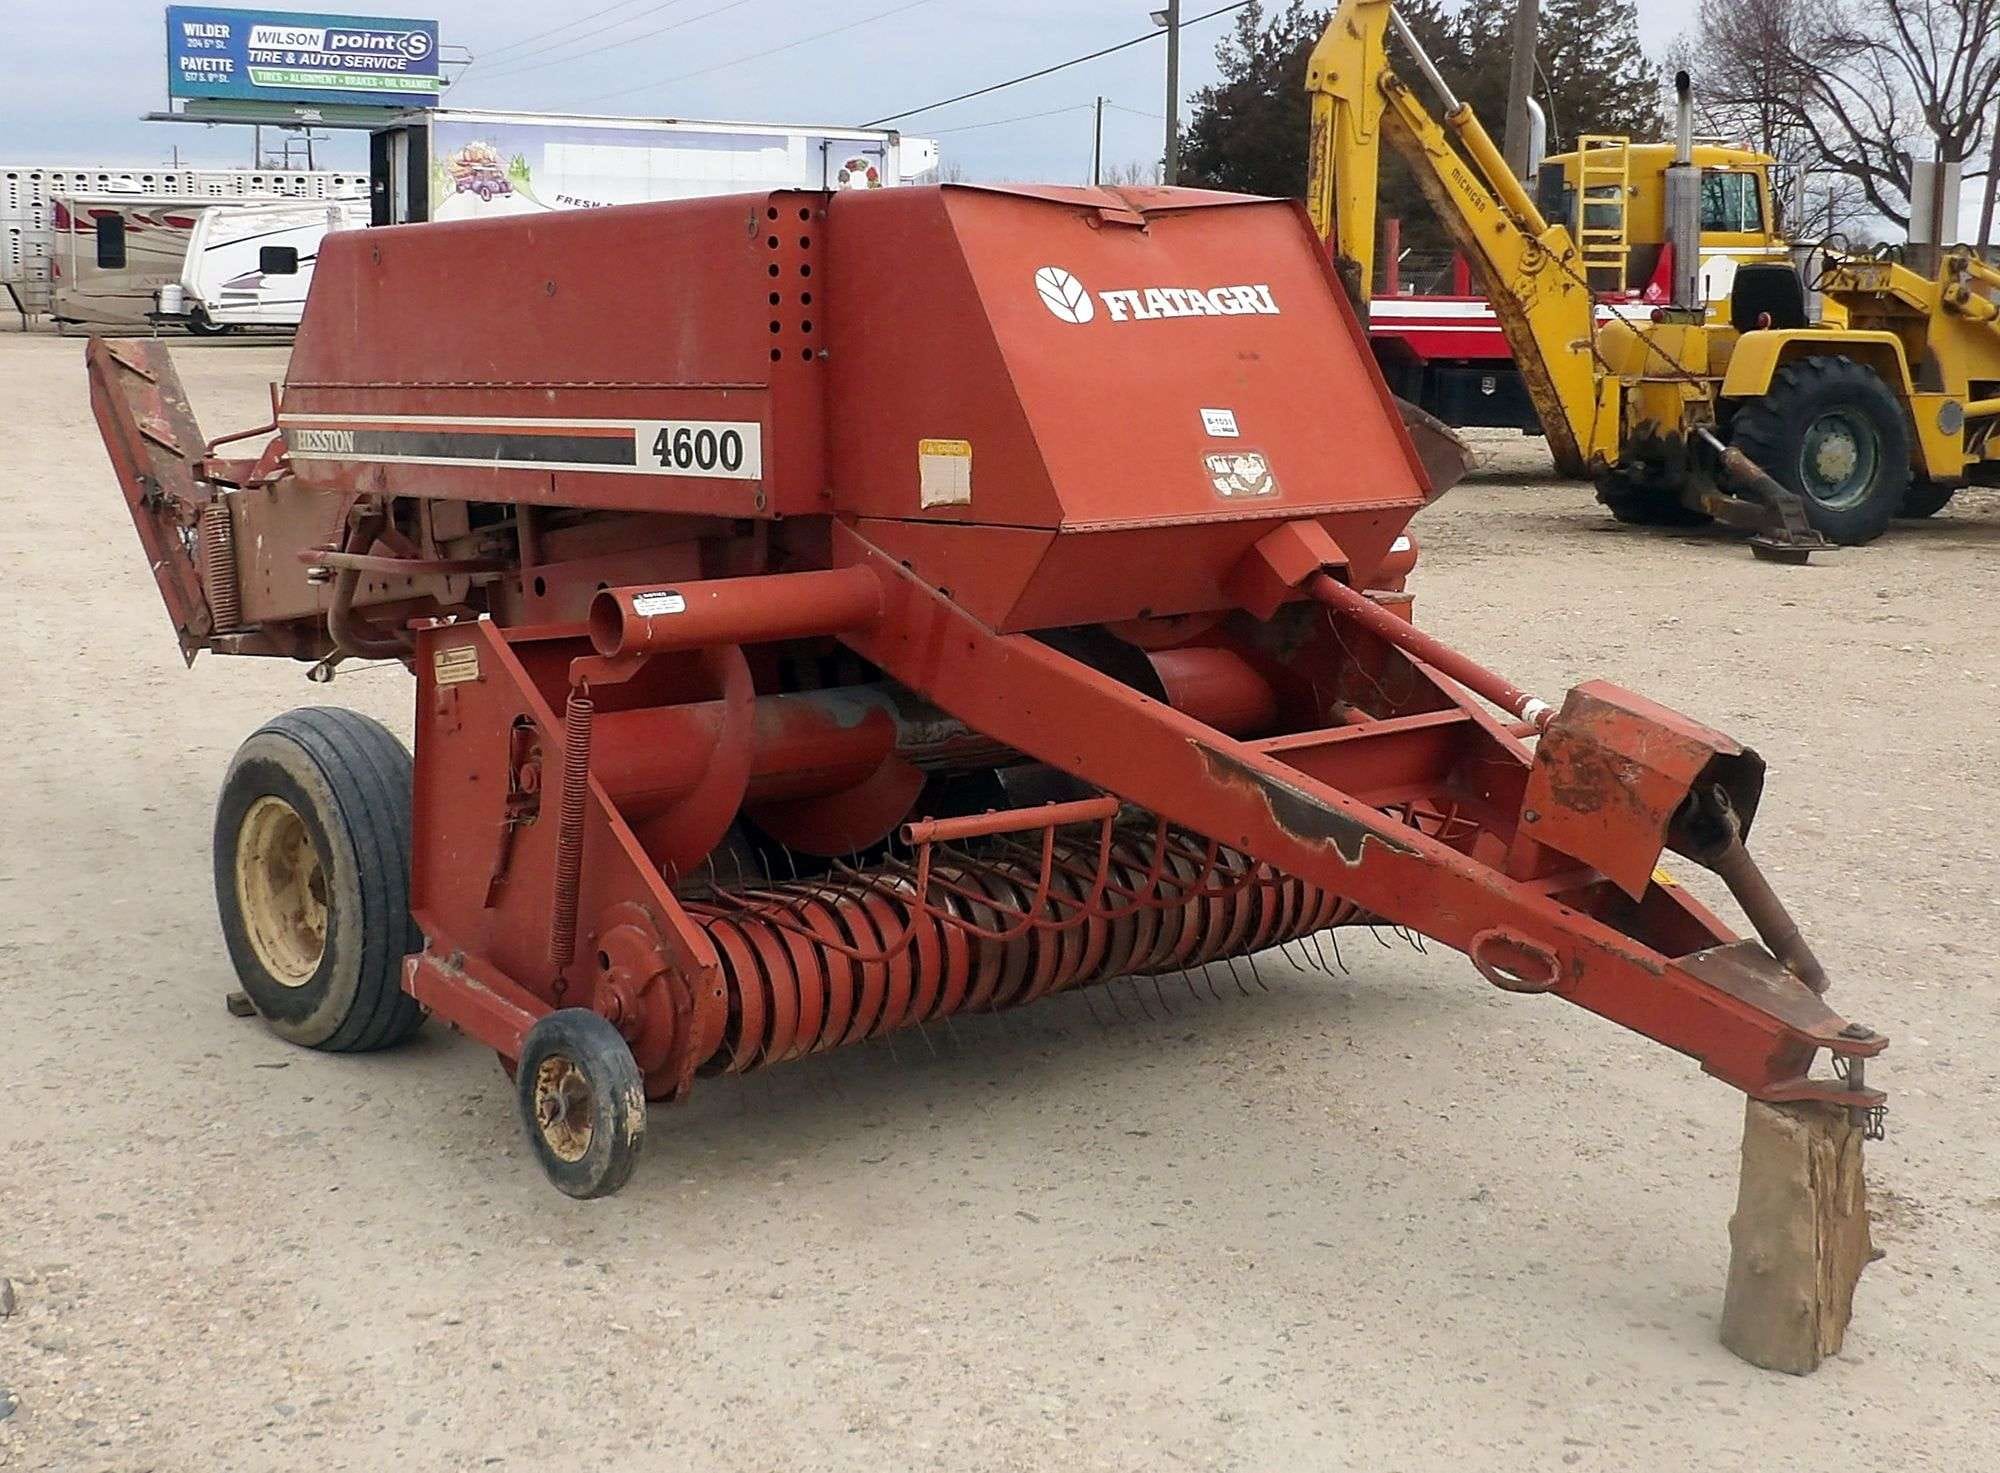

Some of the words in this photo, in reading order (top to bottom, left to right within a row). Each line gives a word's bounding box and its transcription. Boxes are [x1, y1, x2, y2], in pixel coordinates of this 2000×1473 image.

[183, 23, 230, 38] WILDER
[256, 31, 320, 46] WILSON
[331, 33, 395, 50] point
[180, 56, 234, 71] PAYETTE
[249, 50, 282, 63] TIRE
[285, 51, 296, 64] &
[299, 52, 340, 67] AUTO
[344, 55, 407, 70] SERVICE
[257, 71, 283, 82] TIRES
[290, 73, 336, 85] ALIGNMENT
[556, 194, 601, 209] FRESH
[1098, 284, 1281, 322] FIATAGRI
[296, 429, 355, 453] HESSTON
[652, 427, 744, 472] 4600
